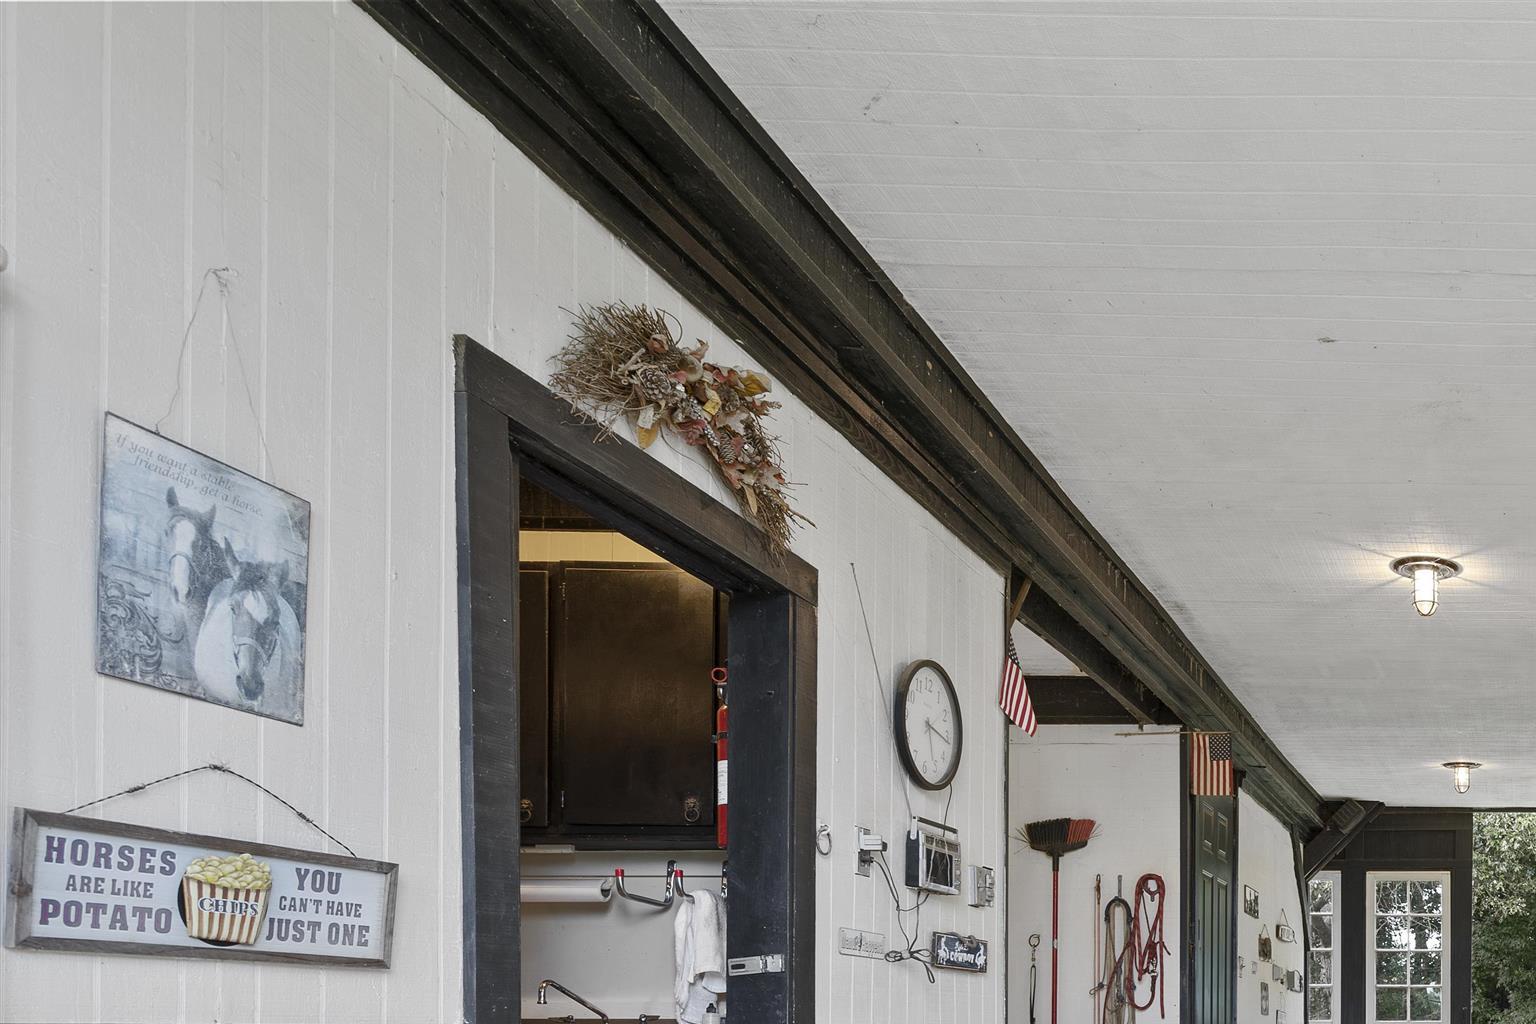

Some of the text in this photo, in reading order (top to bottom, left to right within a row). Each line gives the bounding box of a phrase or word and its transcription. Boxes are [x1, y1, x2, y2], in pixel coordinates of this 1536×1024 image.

[115, 433, 235, 492] If you want a stable
[200, 485, 219, 498] get
[221, 493, 229, 502] a
[925, 677, 933, 693] 12
[942, 709, 949, 723] 2
[44, 835, 177, 876] HORSES
[65, 874, 154, 899] ARE LIKE
[295, 867, 342, 895] YOU
[39, 898, 173, 934] POTATO
[199, 897, 259, 916] CHIPS
[278, 895, 363, 918] CAN'T HAVE
[266, 917, 370, 947] JUST ONE
